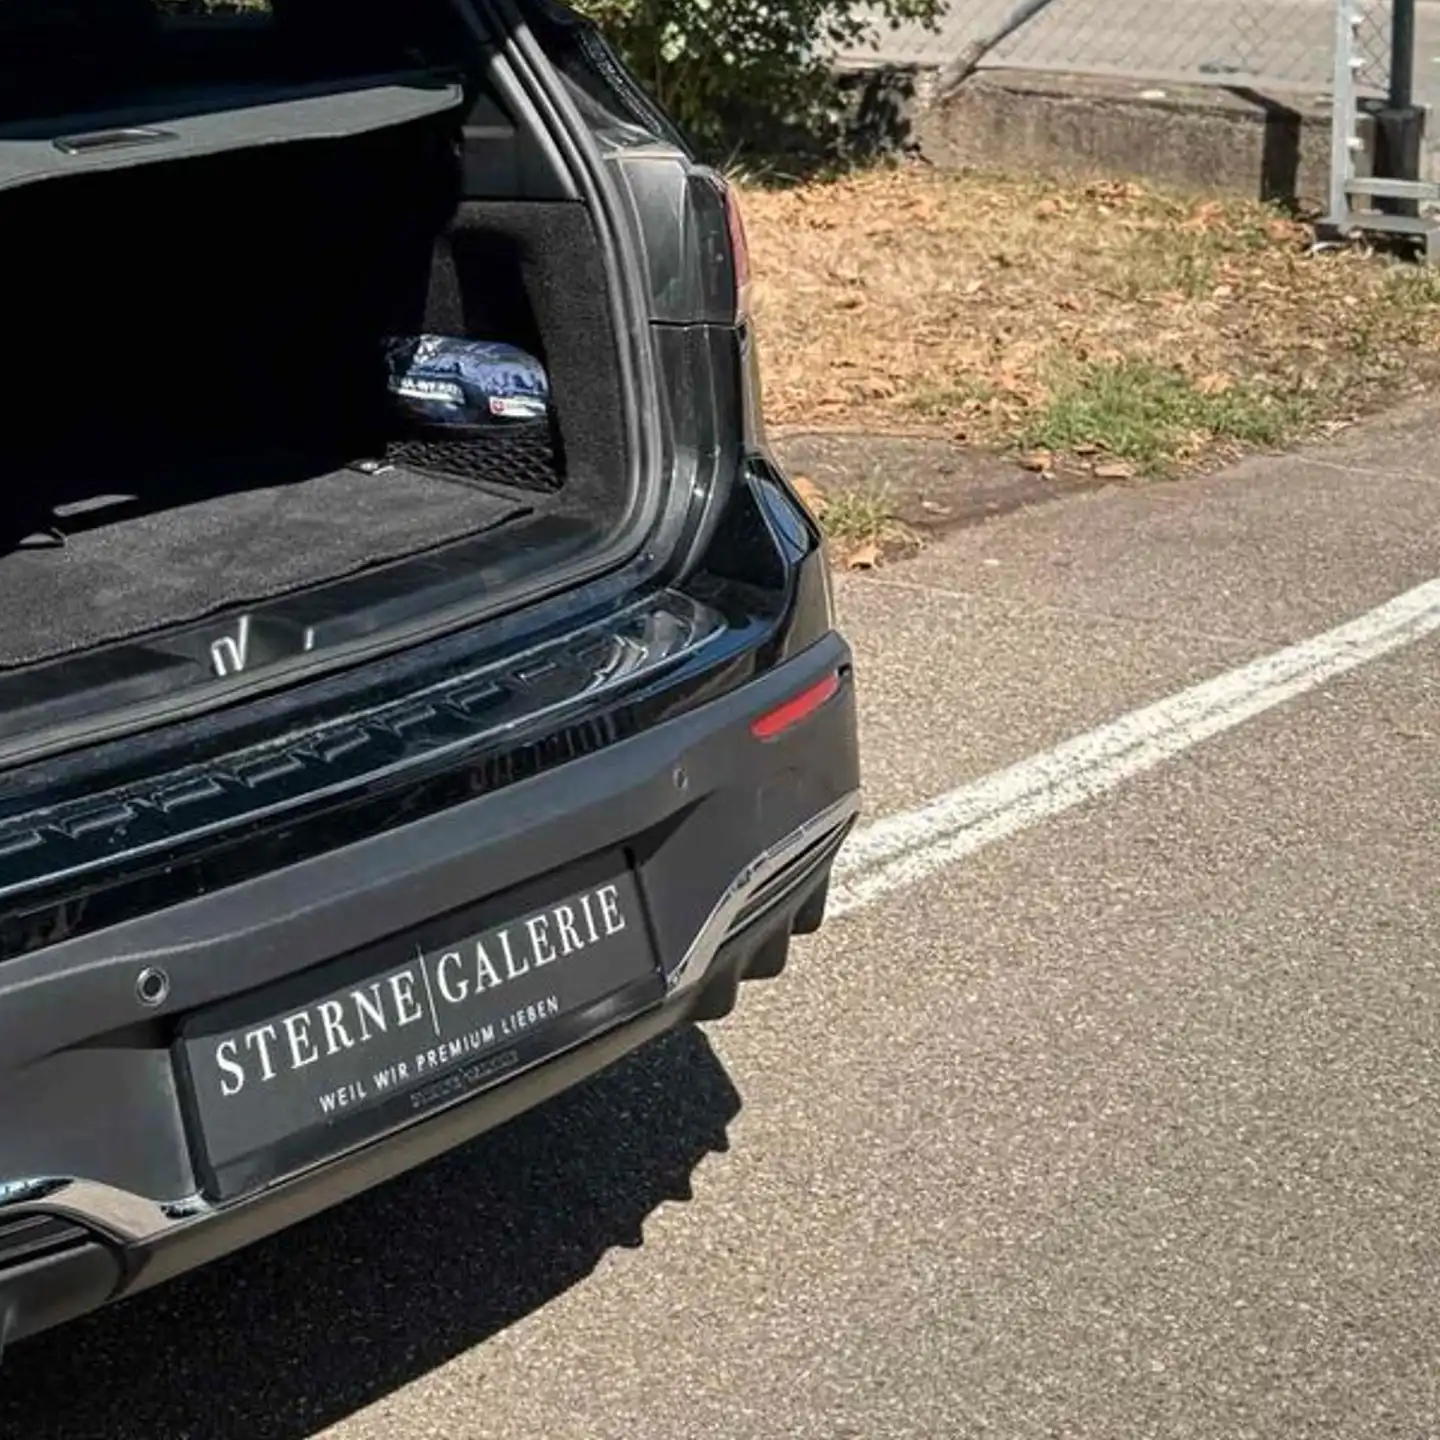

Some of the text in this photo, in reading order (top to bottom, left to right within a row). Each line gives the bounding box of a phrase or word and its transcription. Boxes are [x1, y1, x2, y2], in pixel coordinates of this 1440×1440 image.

[215, 971, 423, 1097] STERNE
[436, 884, 627, 1003] GALERIE
[319, 1081, 367, 1113] WEIL
[373, 1061, 409, 1091] WIR
[416, 1024, 496, 1073] PREMIUM
[501, 994, 559, 1035] LIEBEN
